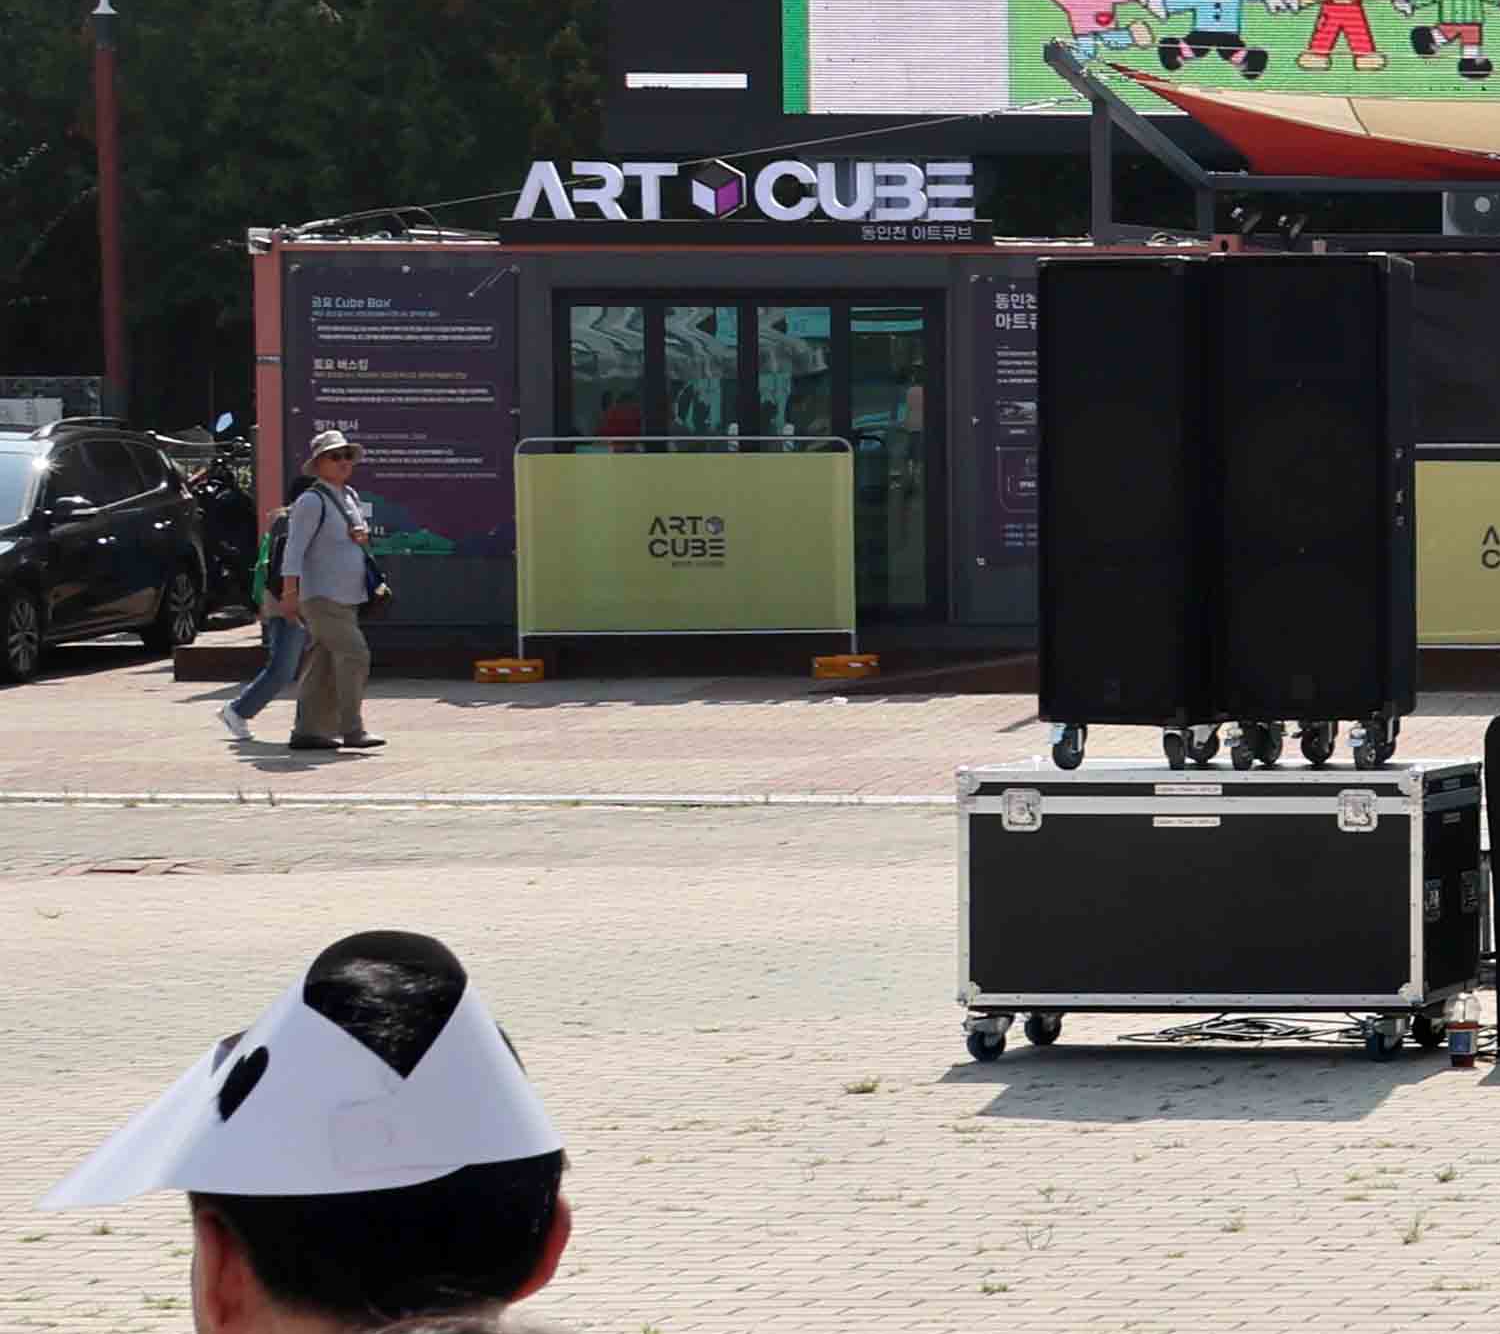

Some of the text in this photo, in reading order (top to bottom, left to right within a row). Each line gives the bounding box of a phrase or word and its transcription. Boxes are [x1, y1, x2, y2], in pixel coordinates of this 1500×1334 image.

[512, 159, 977, 221] ART CUBE
[861, 224, 974, 241] 동인천 아트큐브
[648, 515, 703, 536] ART
[648, 538, 726, 558] CUBE
